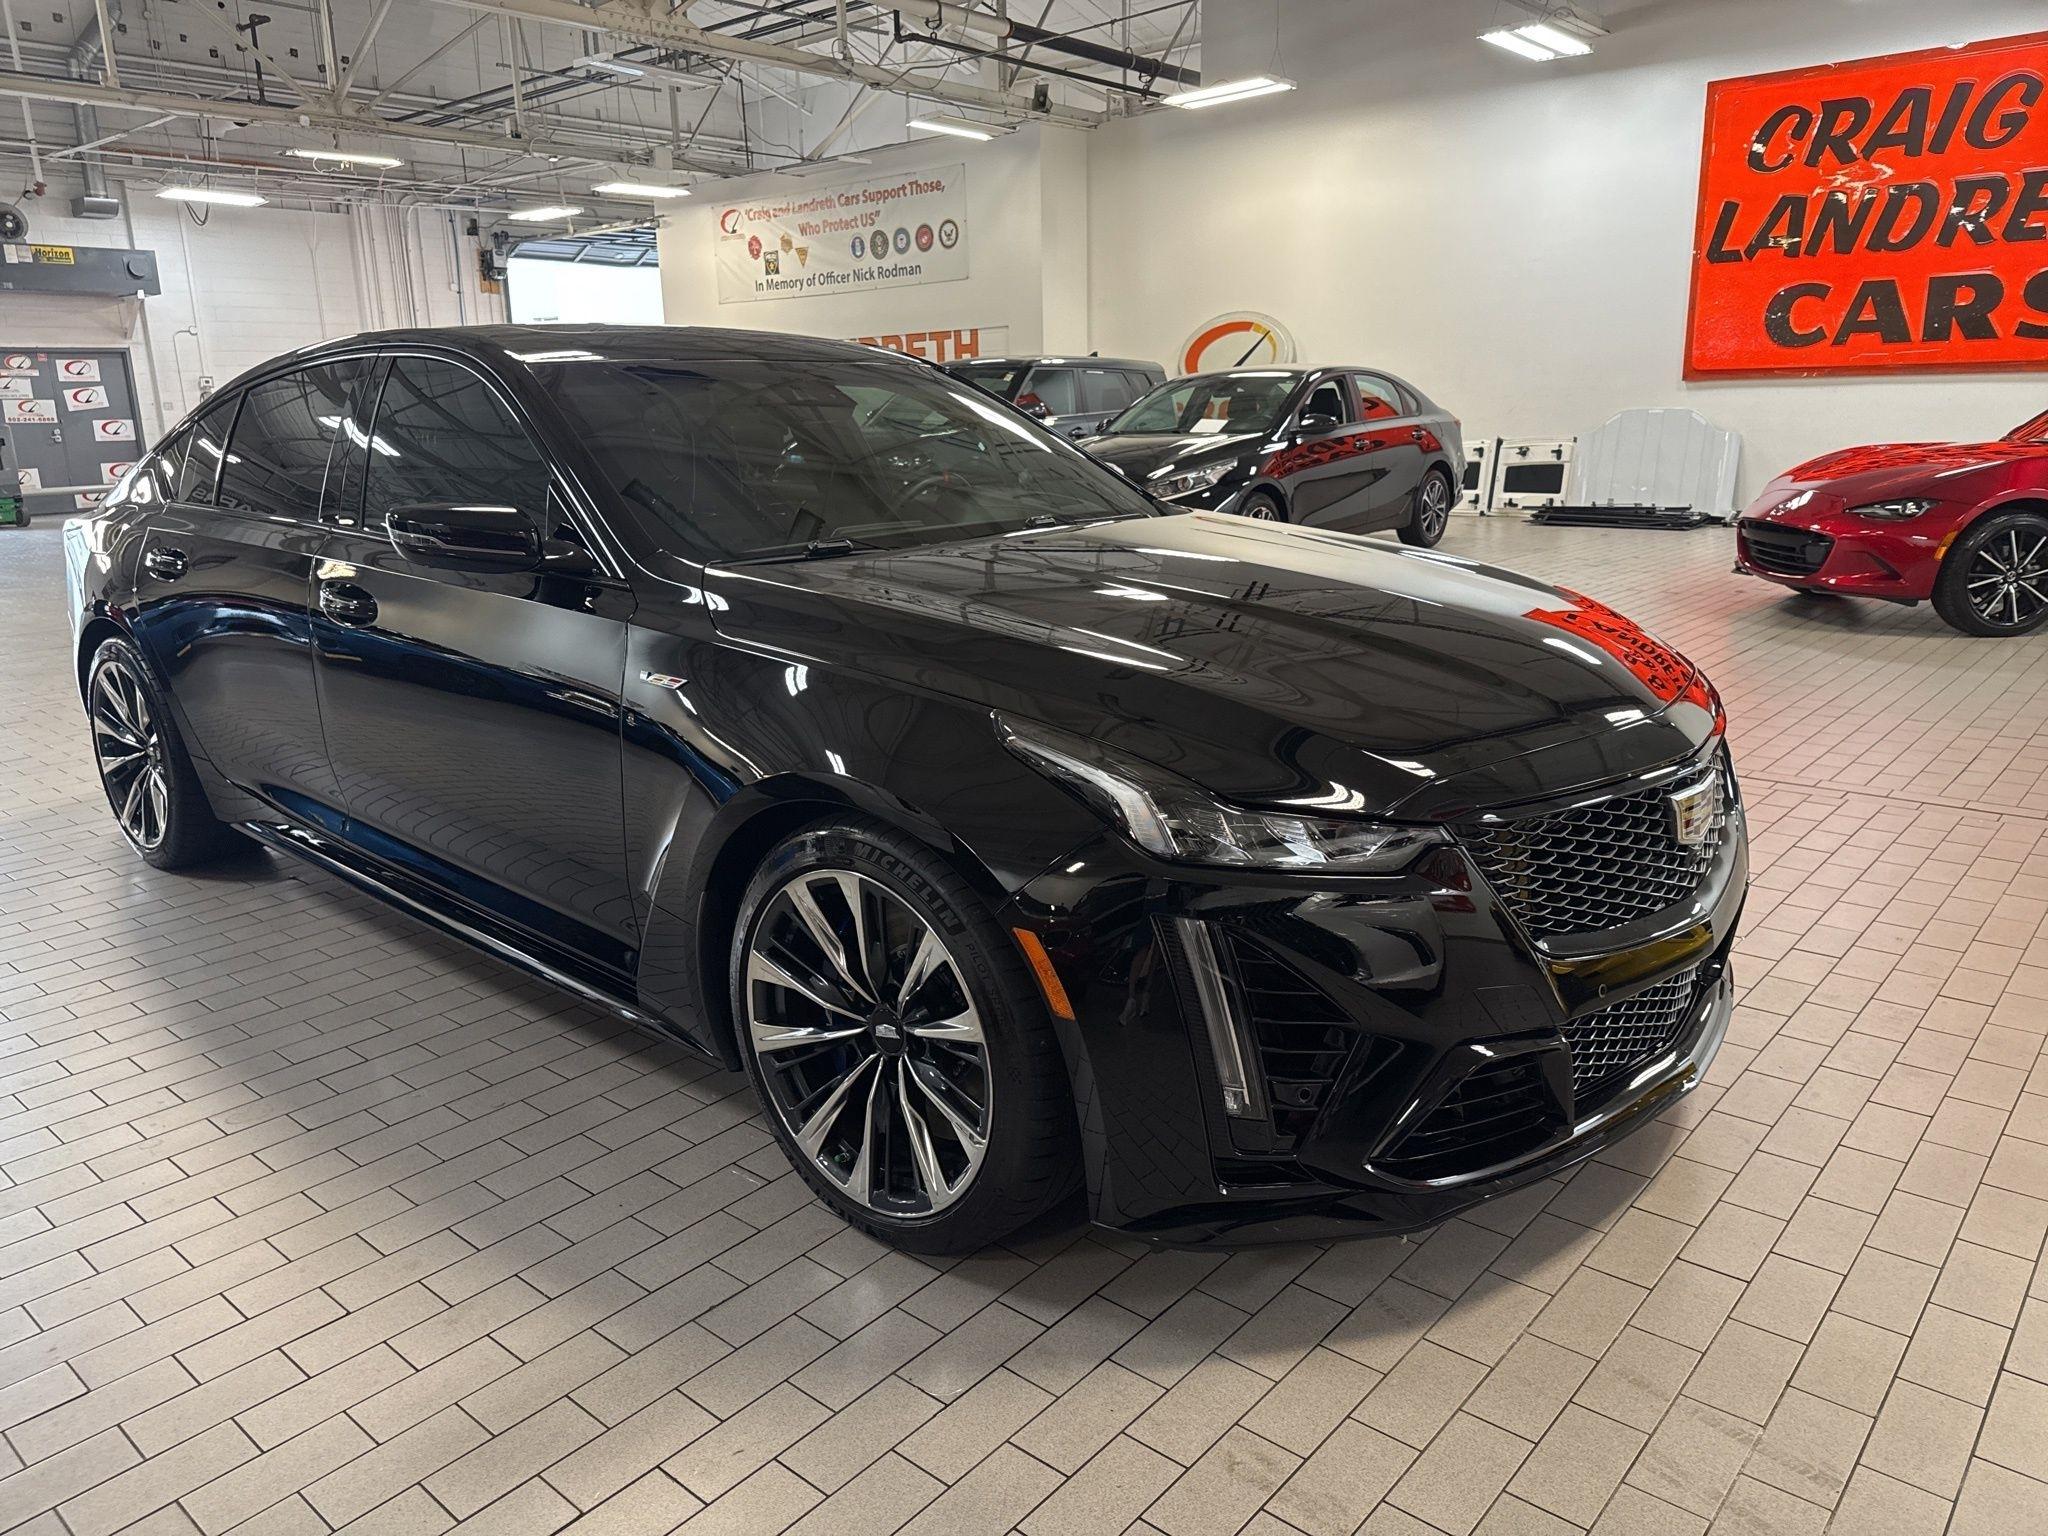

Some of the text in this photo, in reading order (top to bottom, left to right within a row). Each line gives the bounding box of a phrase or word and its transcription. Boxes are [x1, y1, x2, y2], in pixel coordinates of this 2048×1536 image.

[1748, 71, 2044, 173] CRAIG
[792, 195, 836, 214] Landreth
[838, 193, 860, 207] Cars
[862, 184, 907, 204] Support
[909, 180, 945, 196] Those,
[798, 221, 820, 237] Who
[822, 216, 859, 233] Protect
[33, 247, 70, 258] Horizon
[755, 264, 922, 292] In Memory of Officer Nick Rodman
[853, 840, 963, 929] MICHELIN
